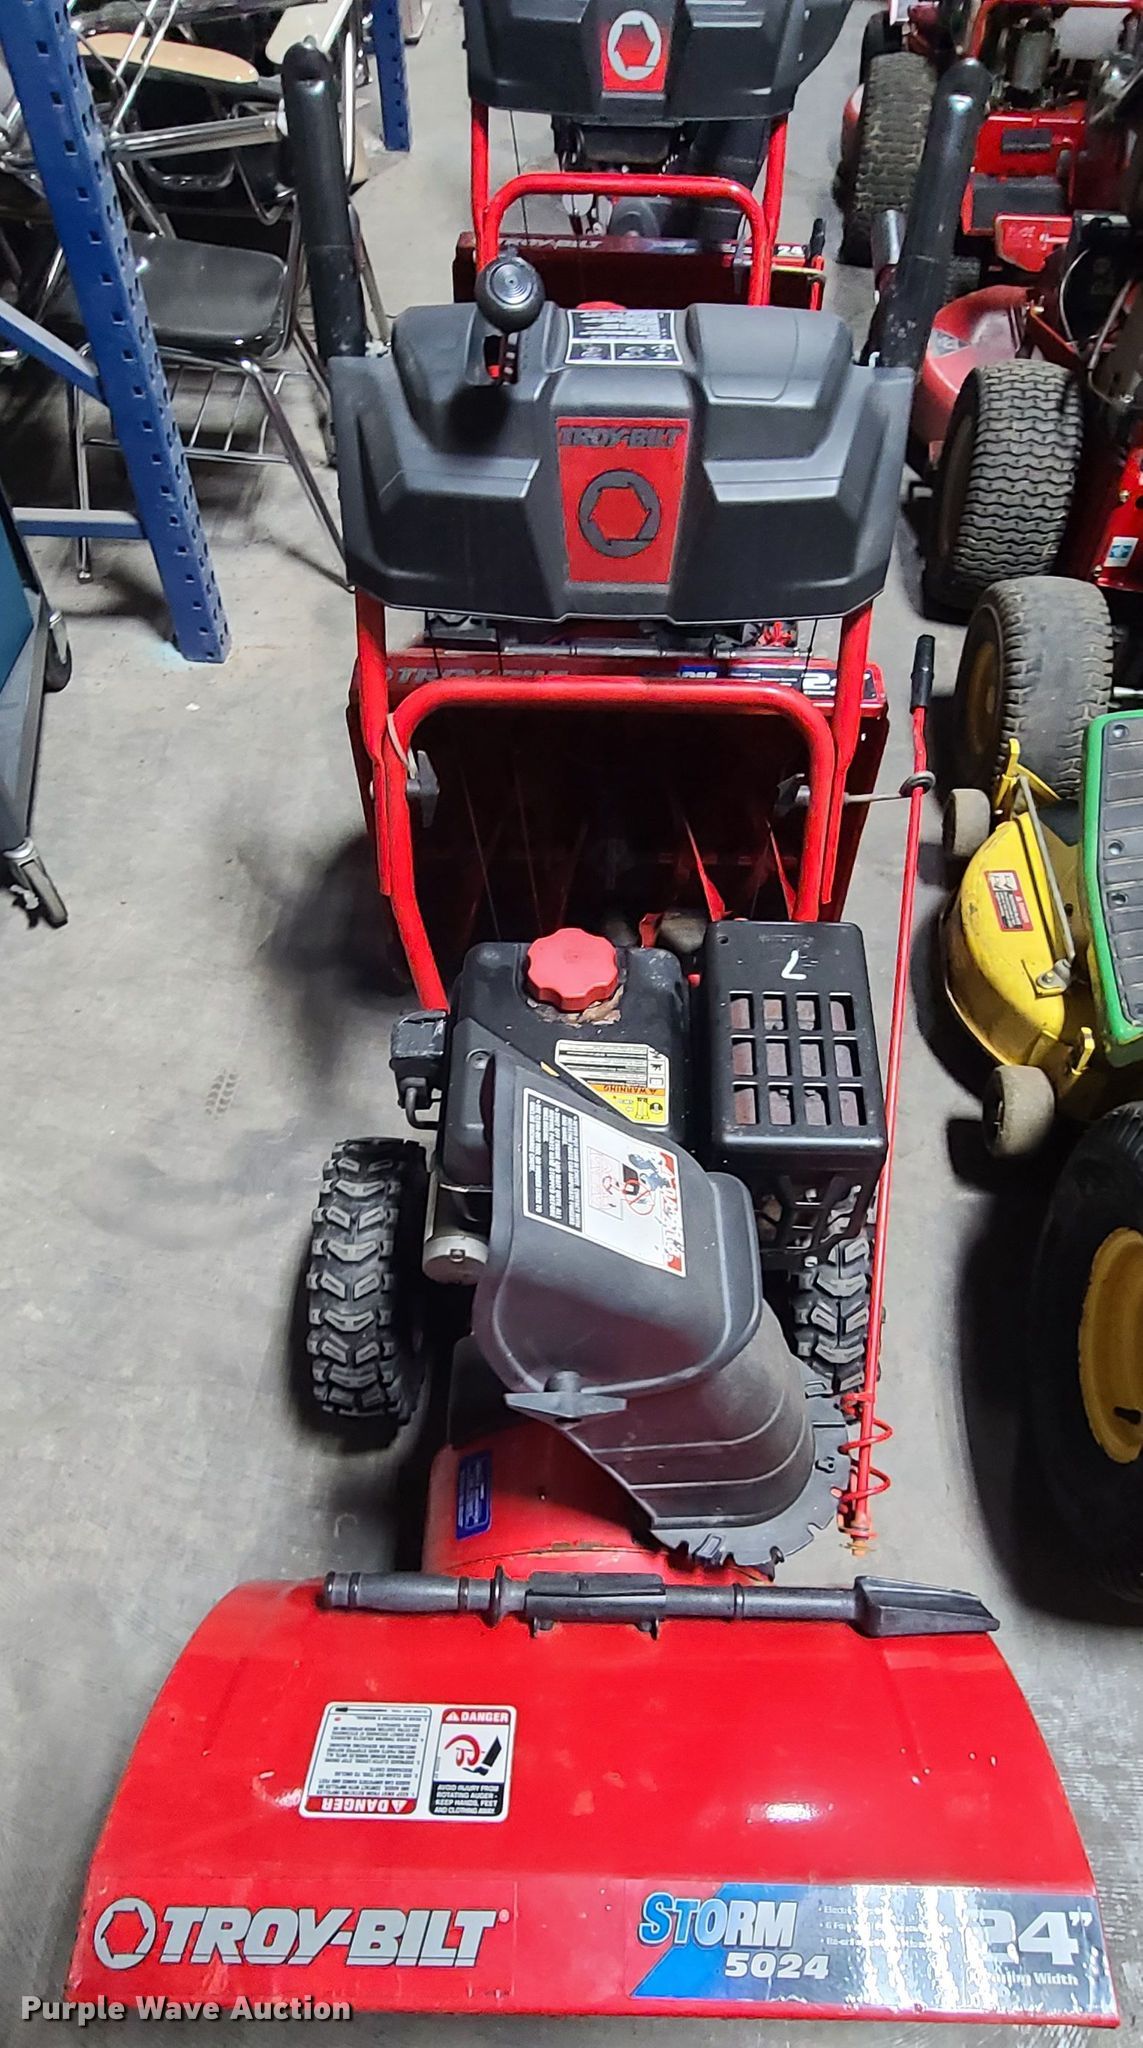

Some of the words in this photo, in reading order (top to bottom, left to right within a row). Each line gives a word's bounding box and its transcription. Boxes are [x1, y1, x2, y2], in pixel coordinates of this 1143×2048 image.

[559, 426, 684, 448] TROY-BILT
[603, 1085, 647, 1095] WARNING
[461, 1712, 509, 1723] DANGER
[321, 1798, 389, 1812] DANGER
[639, 1892, 798, 1949] STORM
[160, 1906, 498, 1968] TROY-BILT
[724, 1952, 830, 1980] 5024
[1033, 1971, 1078, 1986] Width
